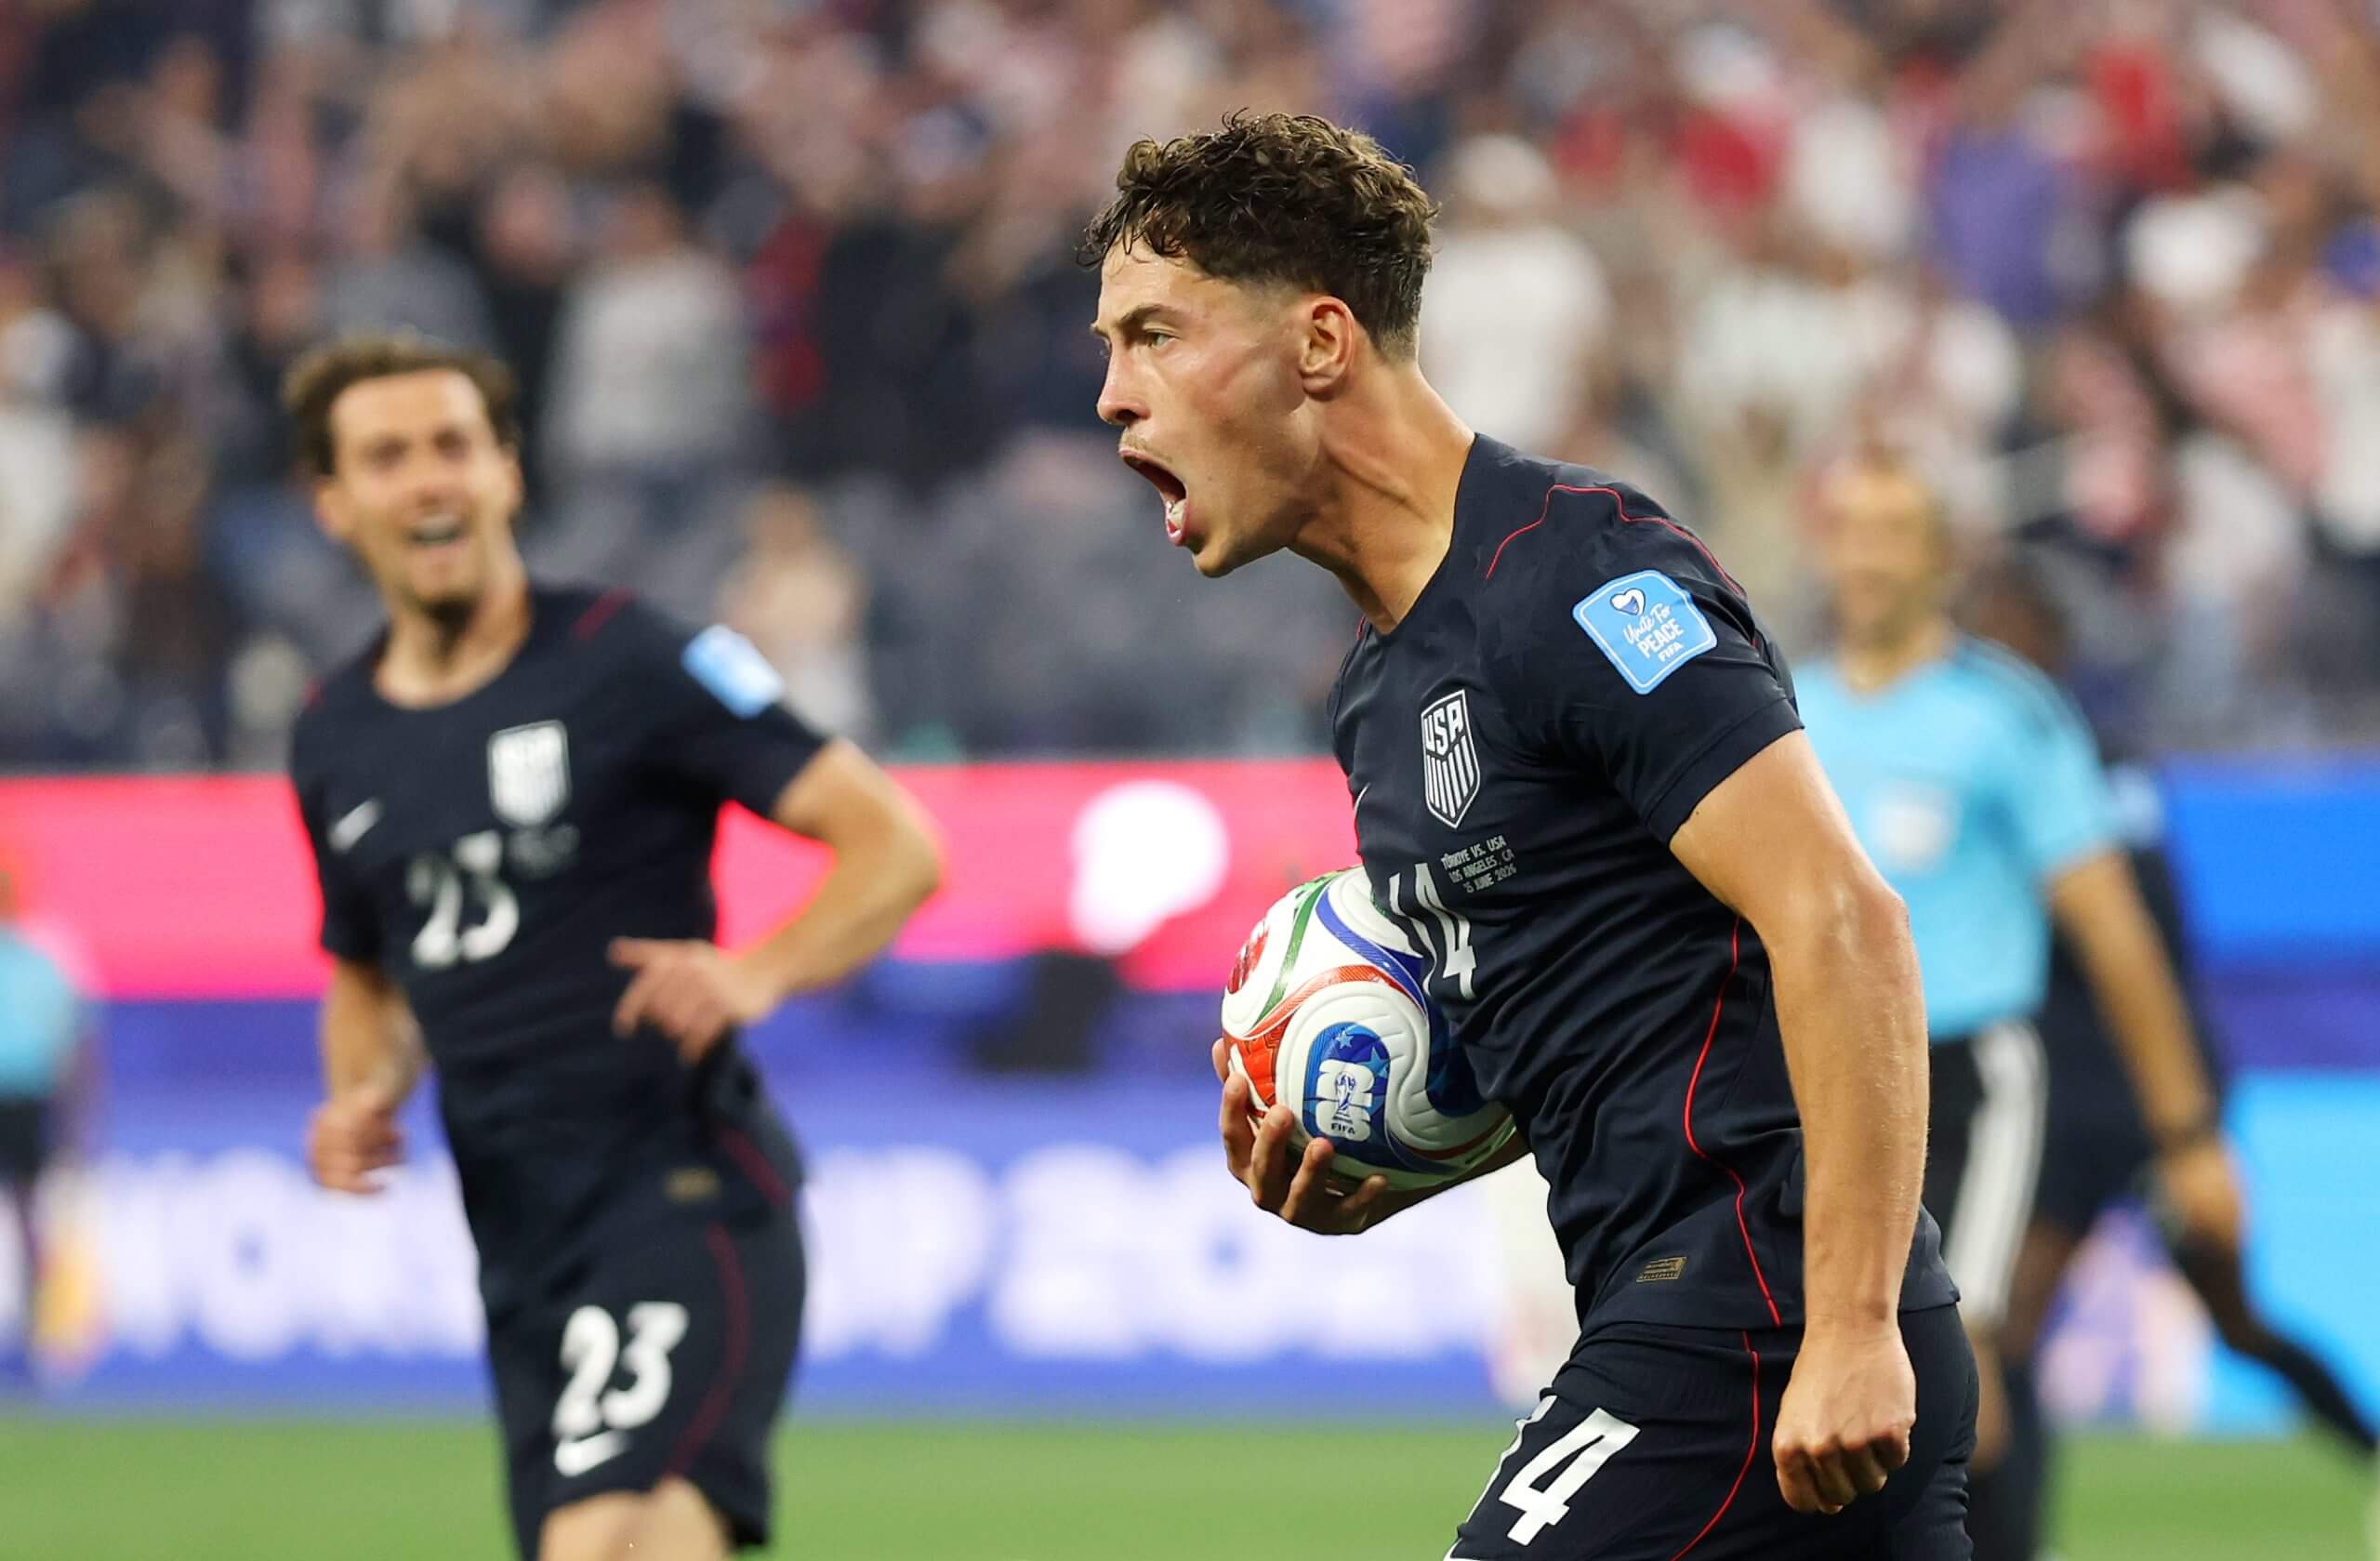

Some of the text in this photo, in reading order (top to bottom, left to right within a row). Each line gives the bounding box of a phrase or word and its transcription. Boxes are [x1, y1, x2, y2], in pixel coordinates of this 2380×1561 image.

[1636, 618, 1685, 659] PEACE
[1658, 642, 1685, 662] FIFA
[1424, 699, 1464, 755] USA
[1487, 835, 1507, 852] USA
[1448, 869, 1463, 883] LOS
[1502, 849, 1514, 861] CA
[1474, 873, 1494, 890] JUNE
[406, 829, 520, 968] 23
[1330, 1122, 1355, 1135] FIFA
[552, 1301, 689, 1441] 23
